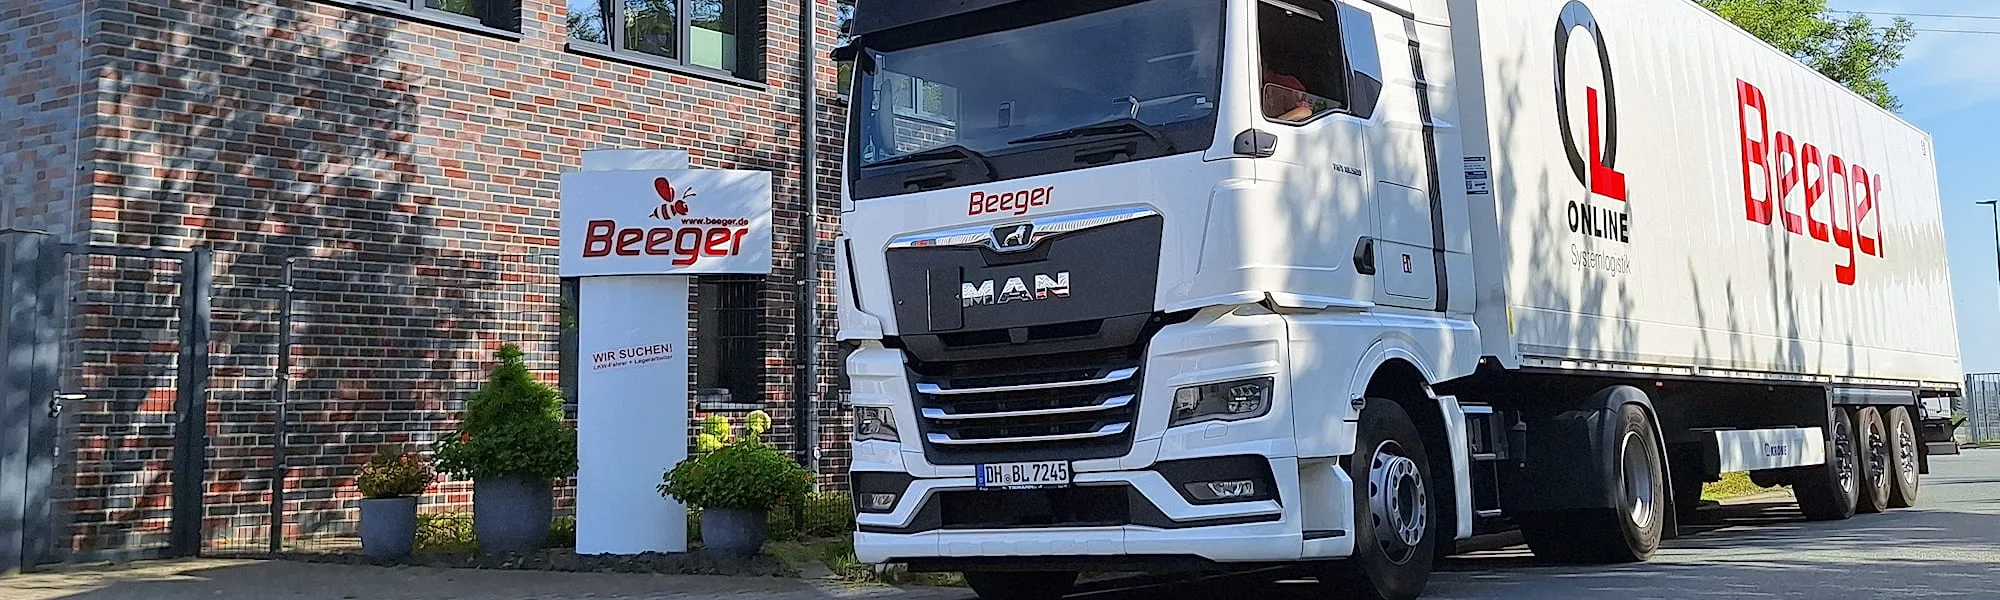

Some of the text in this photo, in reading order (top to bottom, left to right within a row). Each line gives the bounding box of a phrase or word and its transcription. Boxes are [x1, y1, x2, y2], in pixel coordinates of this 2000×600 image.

[1736, 78, 1884, 286] Beeger
[968, 186, 1054, 215] Beeger
[681, 217, 749, 227] www.beeger.de
[1567, 200, 1629, 244] ONLINE
[582, 220, 749, 265] Beeger
[1570, 243, 1632, 277] Systemlogistik
[961, 271, 1070, 308] MAN
[593, 343, 673, 363] WIR SUCHEN!
[985, 463, 1067, 484] DH BL 7245
